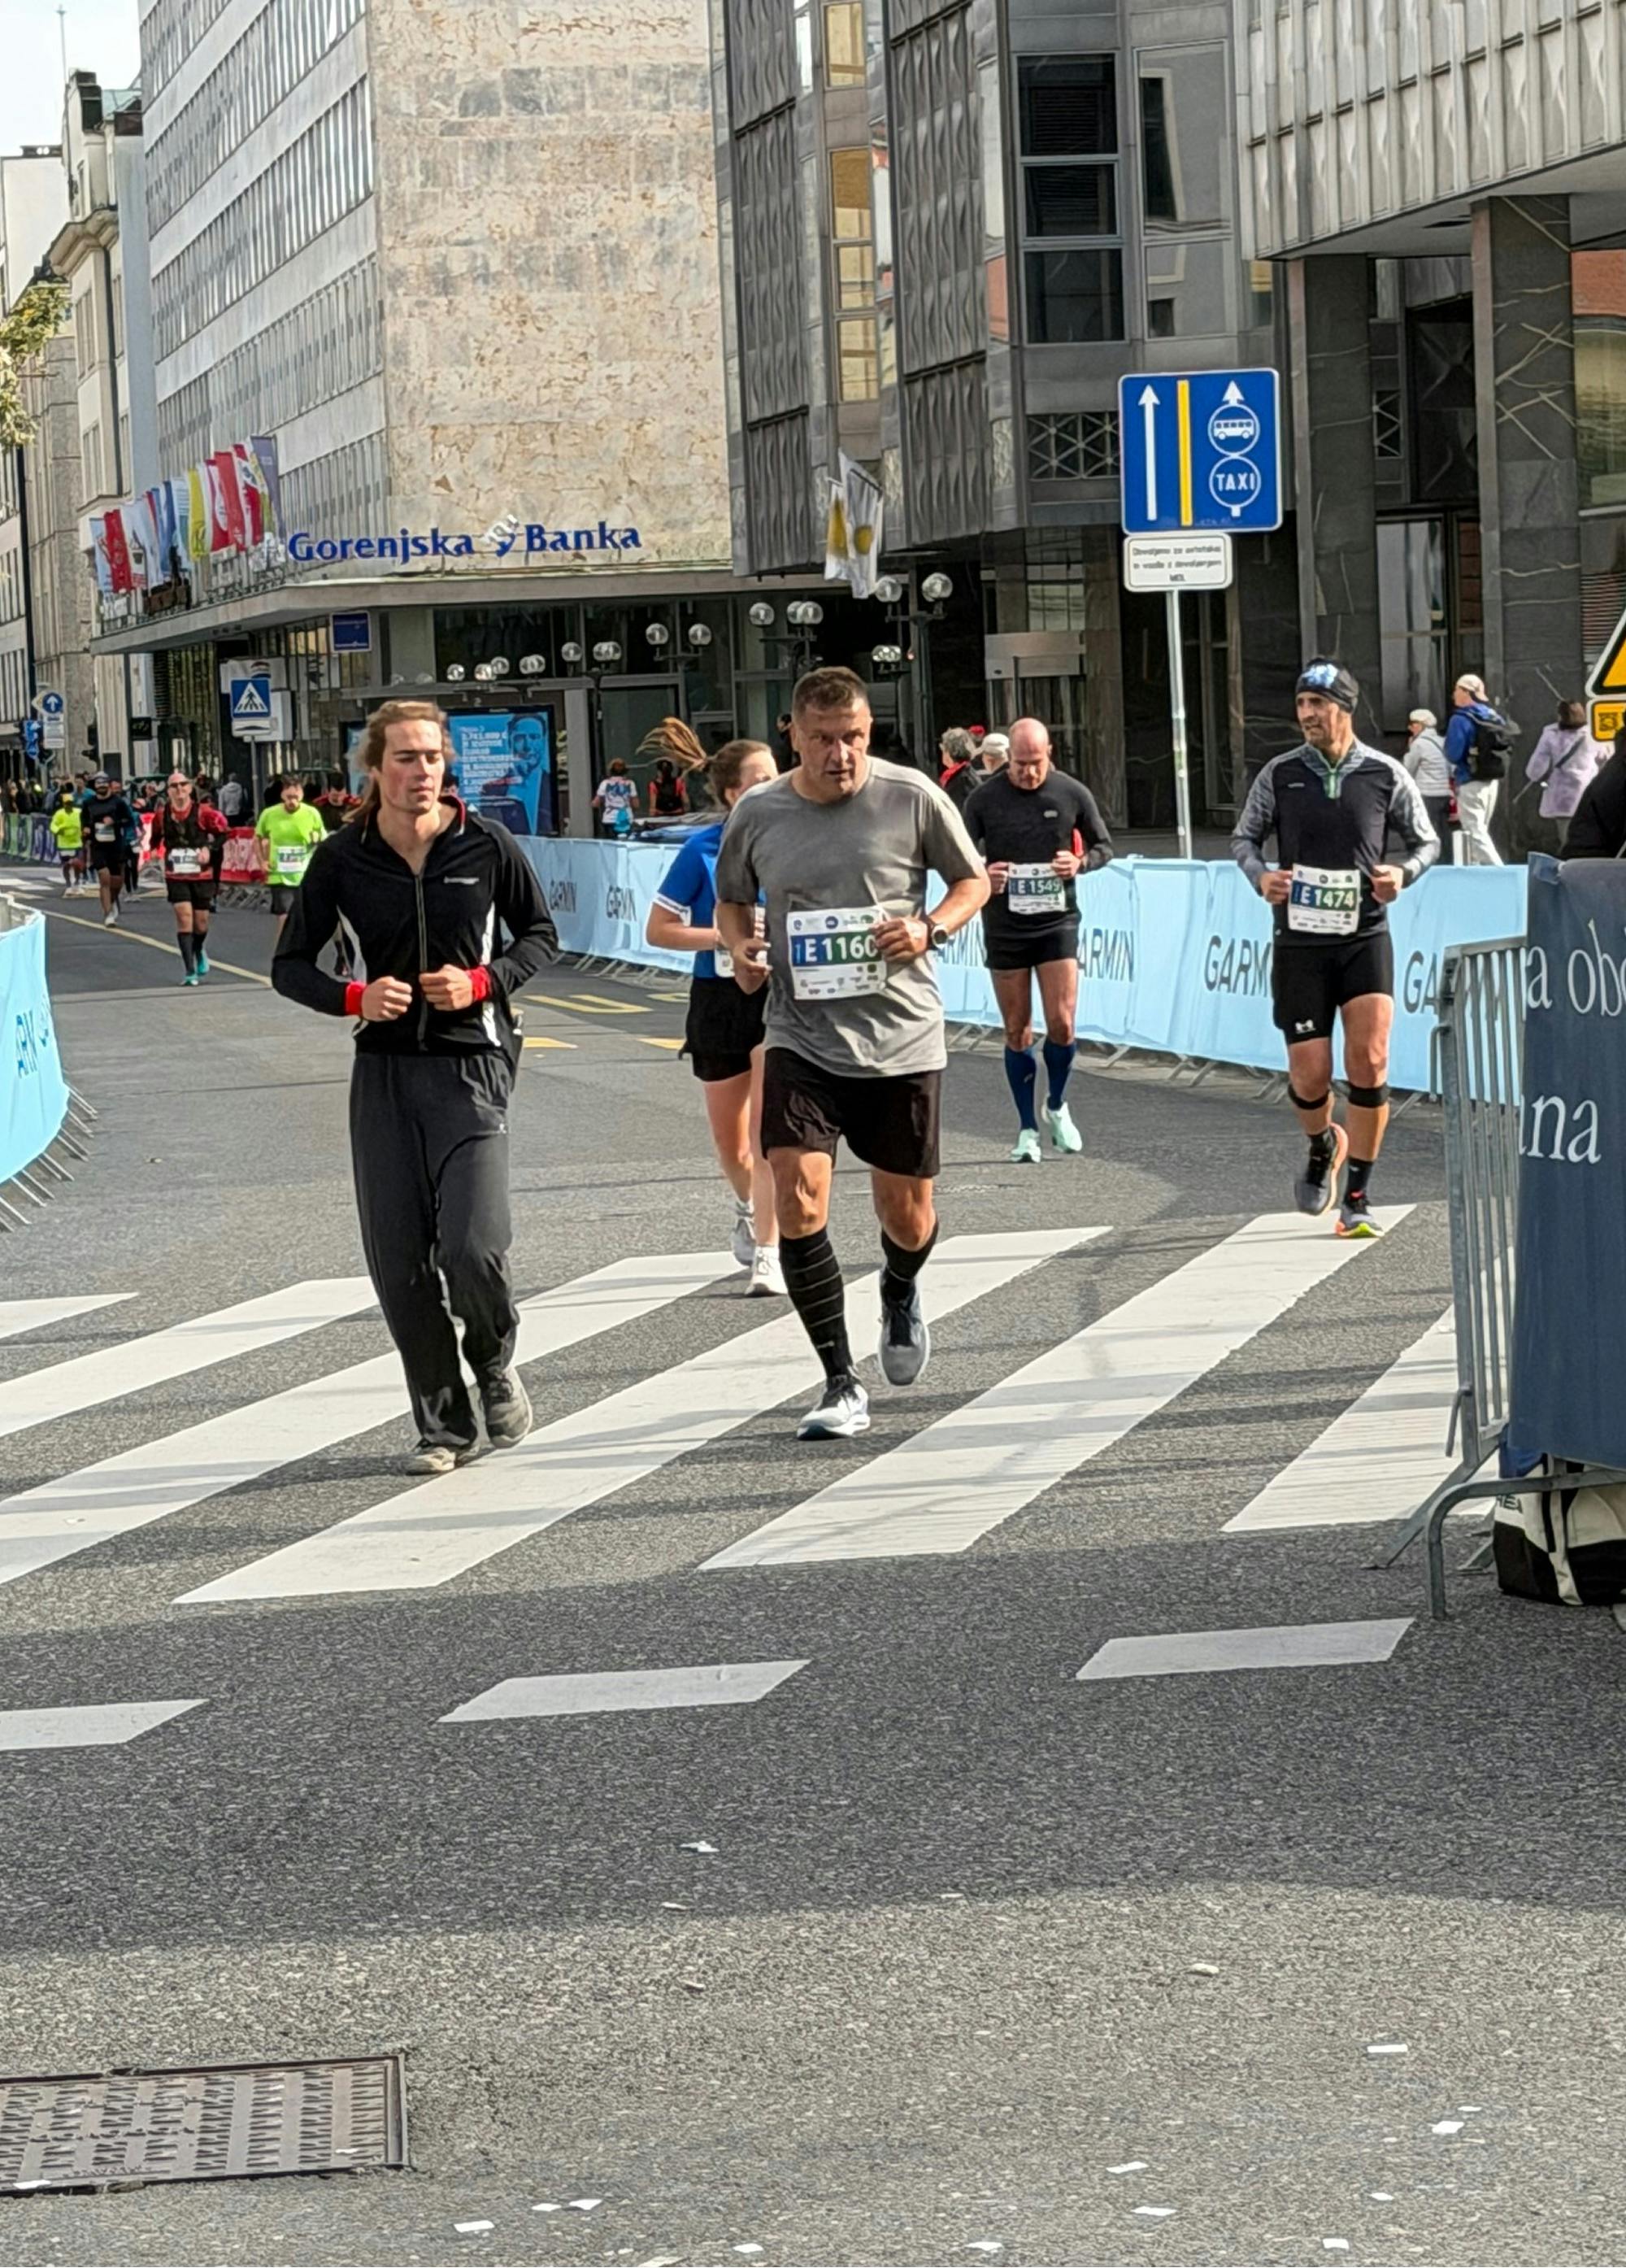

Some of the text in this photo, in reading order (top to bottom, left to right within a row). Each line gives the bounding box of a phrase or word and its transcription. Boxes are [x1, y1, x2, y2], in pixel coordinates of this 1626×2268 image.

[1216, 473, 1255, 492] TAXI
[289, 520, 642, 564] Gorenjska Banka
[1567, 917, 1626, 1016] ob
[1519, 1095, 1602, 1164] na
